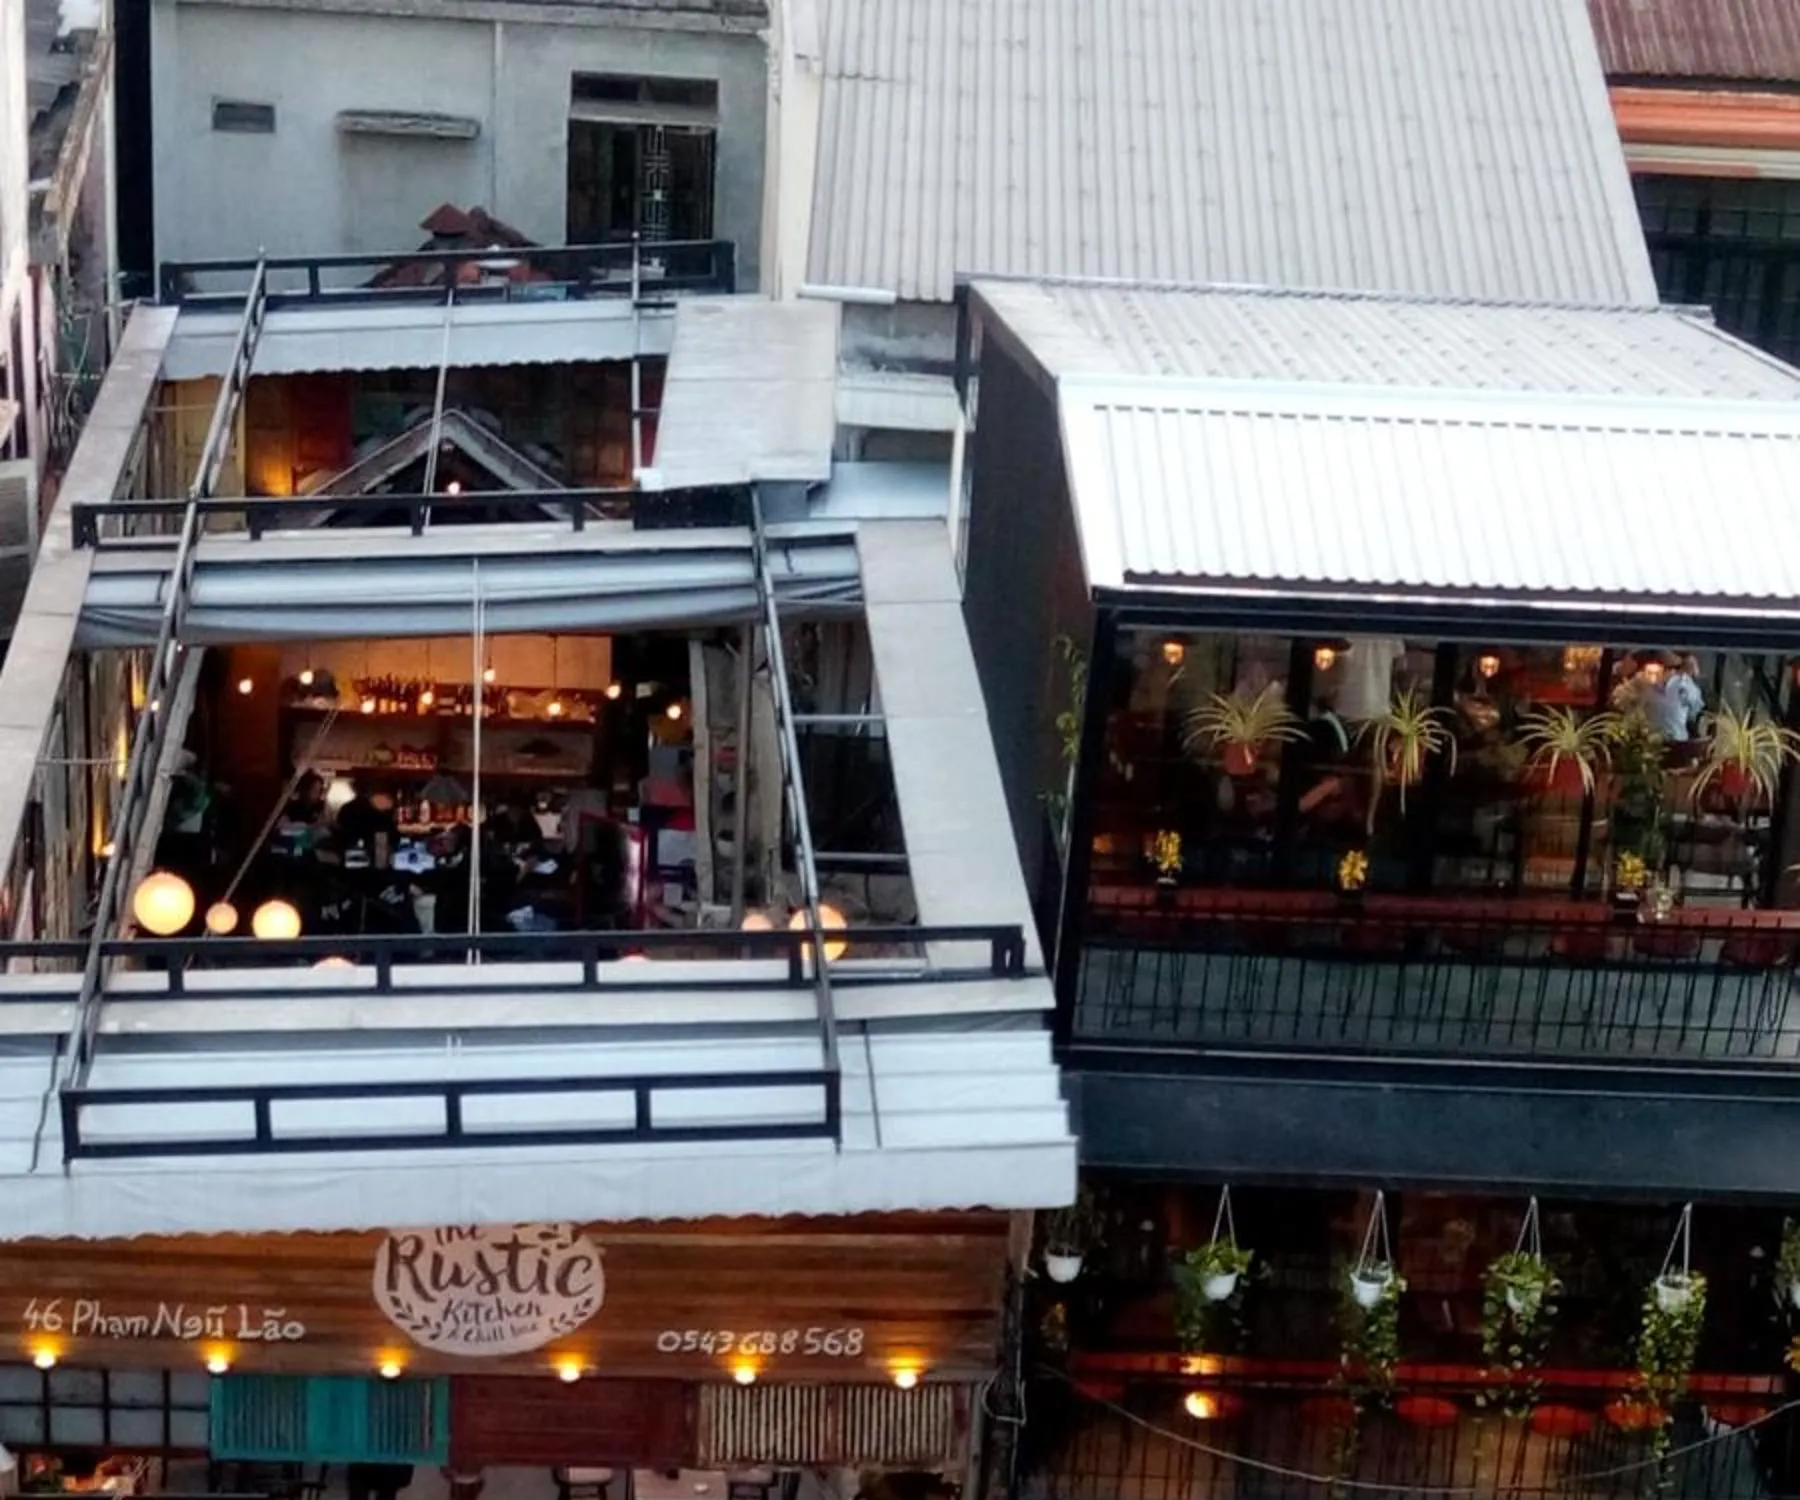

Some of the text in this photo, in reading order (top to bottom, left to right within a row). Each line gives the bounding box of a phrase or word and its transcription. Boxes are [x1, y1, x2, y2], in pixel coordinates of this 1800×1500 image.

[386, 1233, 596, 1304] Rustic
[22, 1297, 64, 1333] 46
[72, 1299, 150, 1341] Phạm
[236, 1303, 307, 1341] Lão
[442, 1297, 542, 1326] Kitchen
